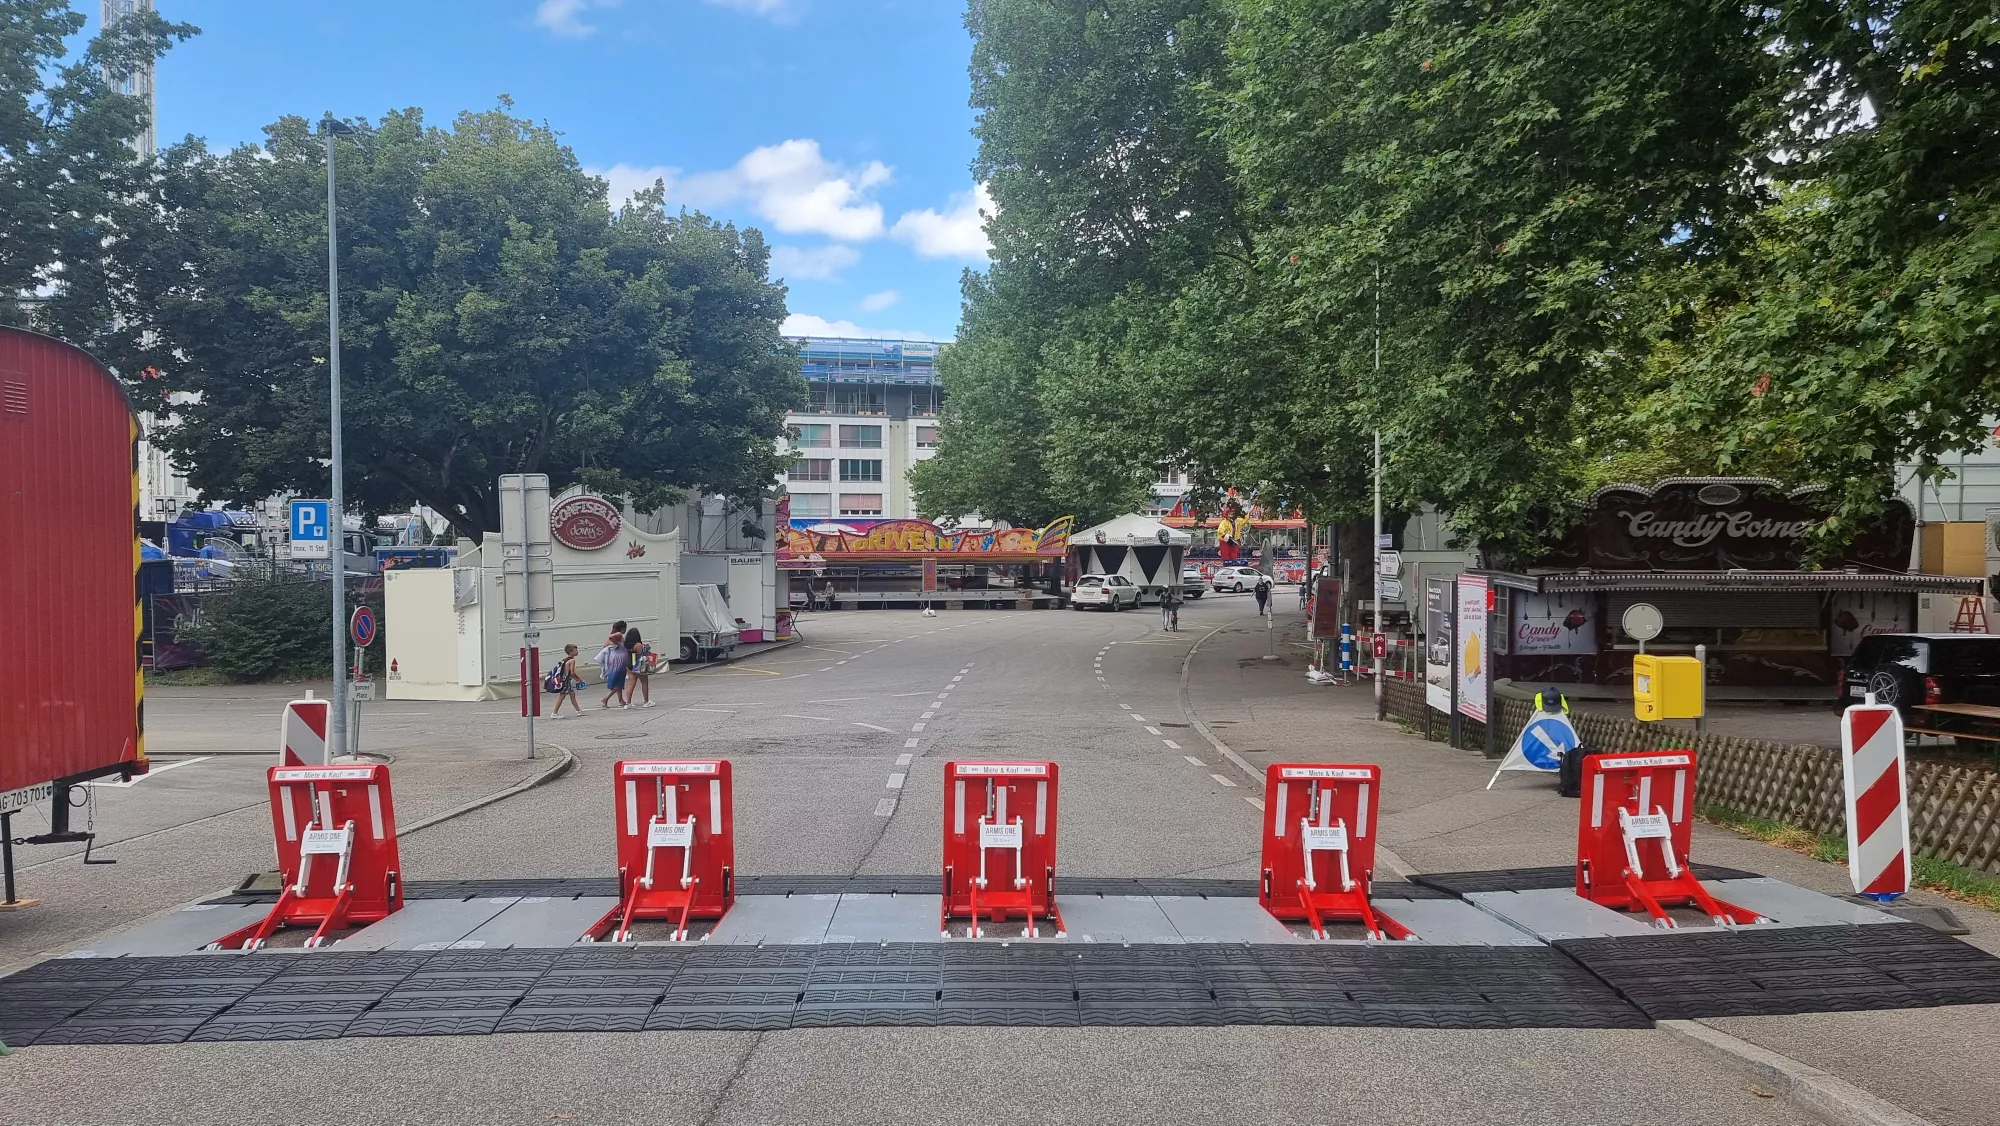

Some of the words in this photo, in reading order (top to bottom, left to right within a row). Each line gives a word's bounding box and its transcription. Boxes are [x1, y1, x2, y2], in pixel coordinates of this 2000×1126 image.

[298, 506, 316, 535] P
[553, 501, 620, 530] CONFISERIE
[569, 523, 605, 539] dany's
[1617, 511, 1725, 548] Candy
[1715, 511, 1812, 539] Corne
[853, 531, 925, 551] DRIVE
[928, 534, 954, 551] IN
[316, 544, 326, 552] Std.
[1517, 622, 1561, 640] Candy
[650, 765, 667, 773] Miete
[1308, 769, 1324, 777] Miete
[303, 771, 321, 780] Miete
[328, 770, 343, 779] Kauf
[1631, 817, 1649, 825] ARMIS
[1649, 816, 1661, 824] ONE
[654, 826, 673, 834] ARMIS
[308, 832, 329, 840] ARMIS
